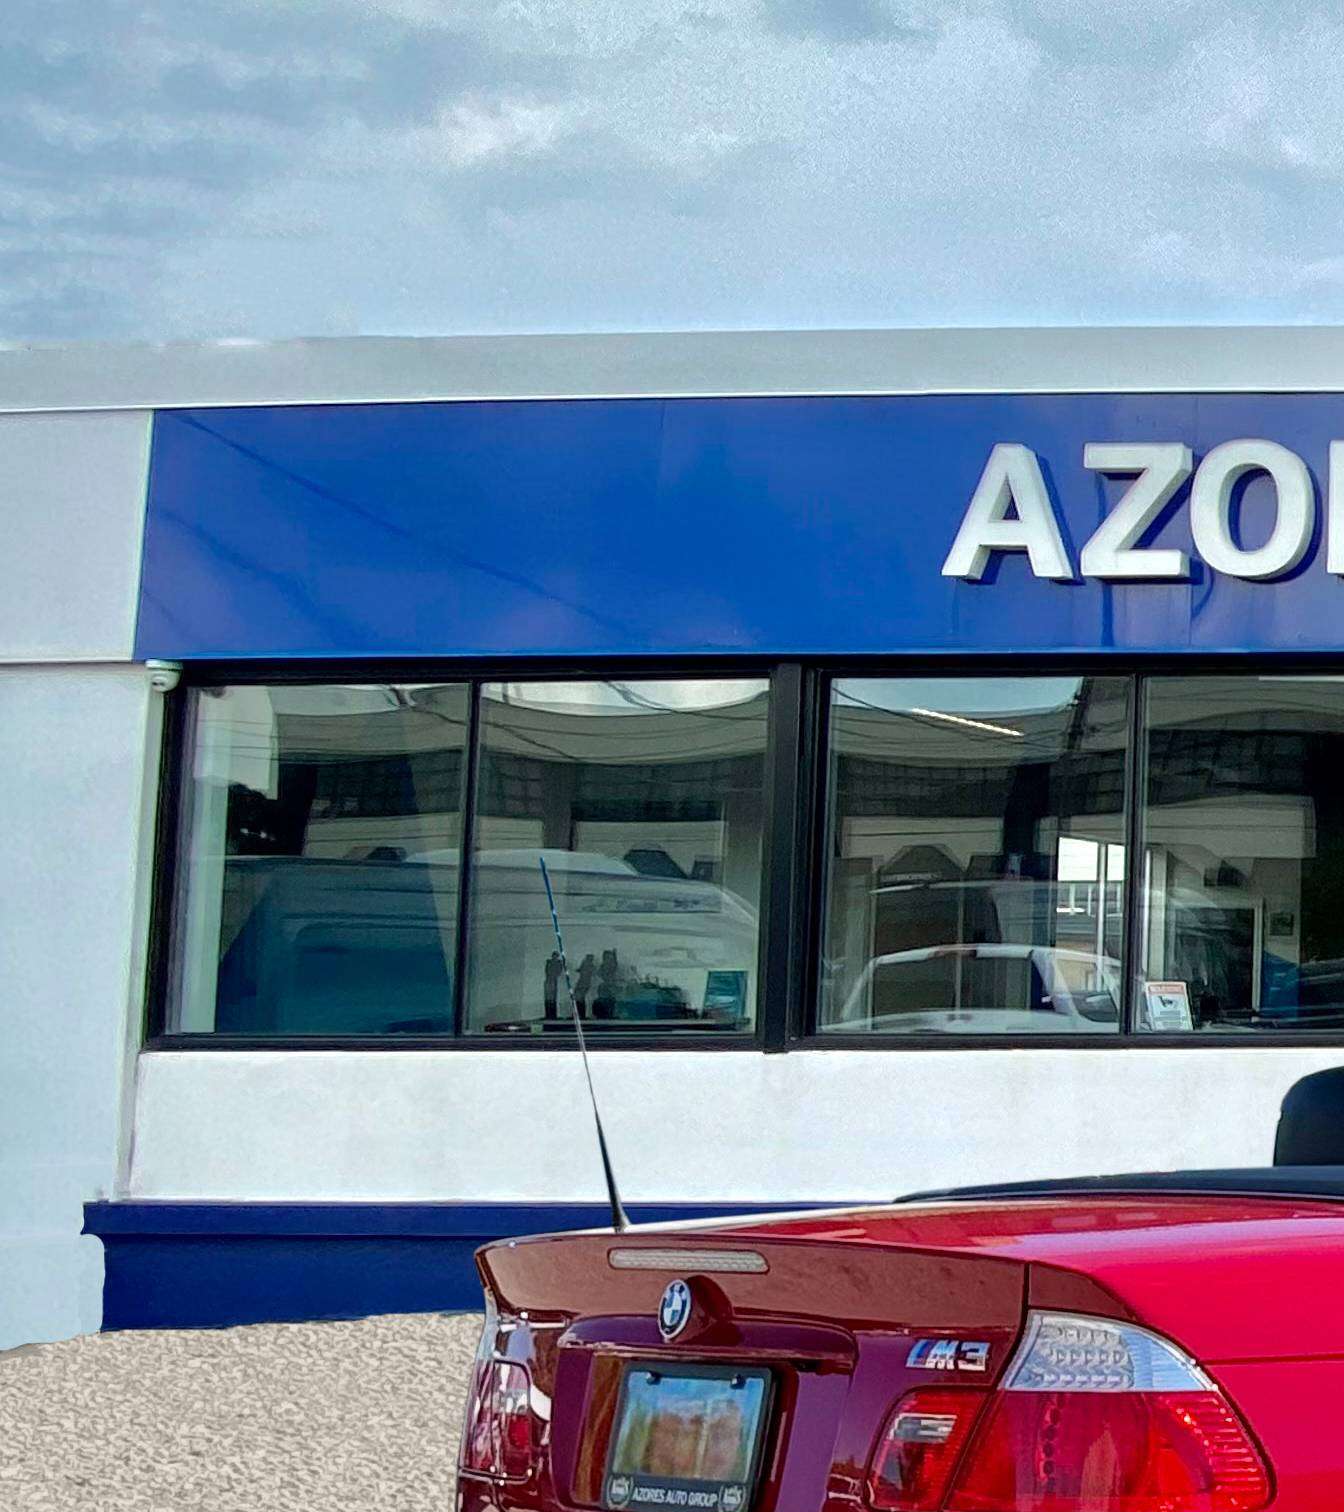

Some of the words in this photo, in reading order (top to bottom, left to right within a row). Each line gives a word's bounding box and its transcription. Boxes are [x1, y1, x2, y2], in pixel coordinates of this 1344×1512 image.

[924, 1339, 991, 1372] M3
[632, 1486, 665, 1503] AZORES
[666, 1490, 688, 1506] AUTO
[688, 1492, 718, 1508] GROUP
